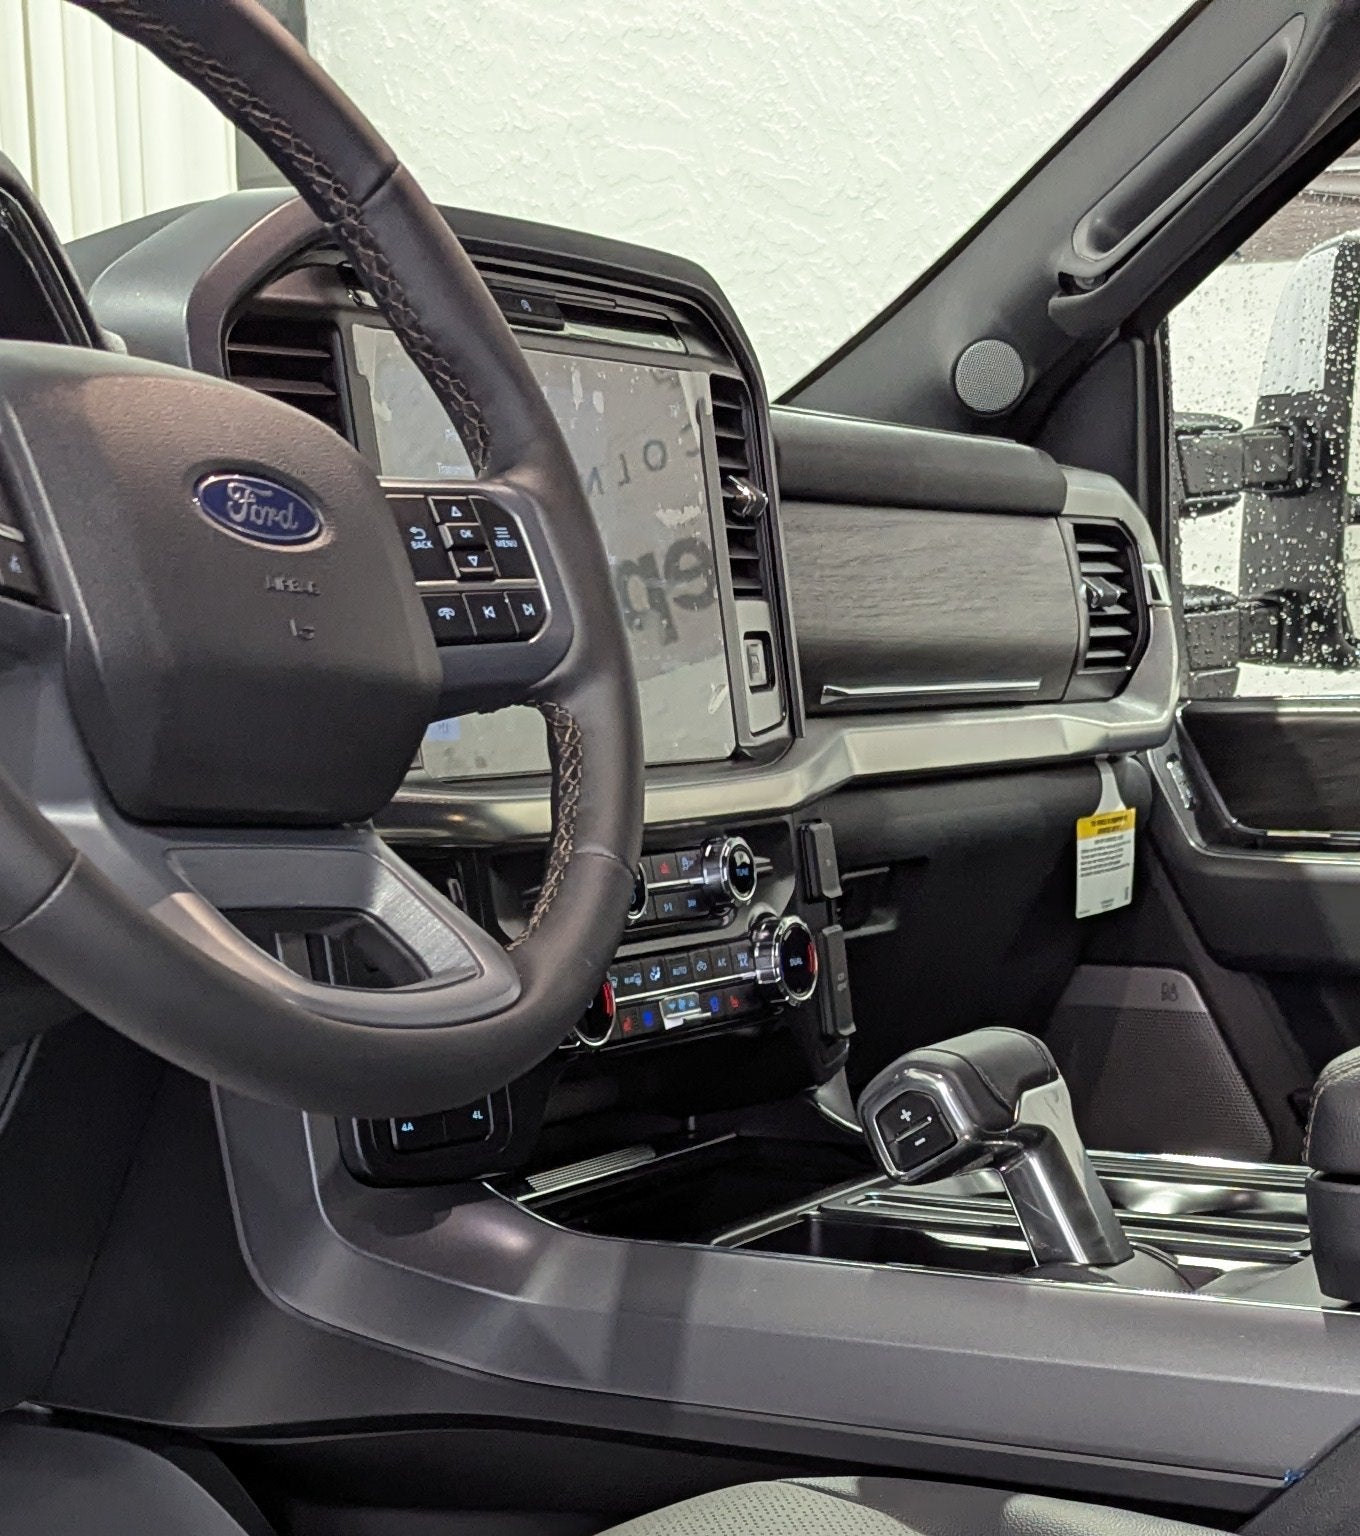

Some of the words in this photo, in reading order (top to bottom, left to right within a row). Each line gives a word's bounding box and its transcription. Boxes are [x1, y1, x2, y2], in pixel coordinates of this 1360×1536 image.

[226, 482, 299, 530] Ford
[410, 539, 434, 550] BACK
[495, 539, 518, 548] MENU
[472, 1110, 484, 1120] 4L
[401, 1121, 415, 1132] 4A
